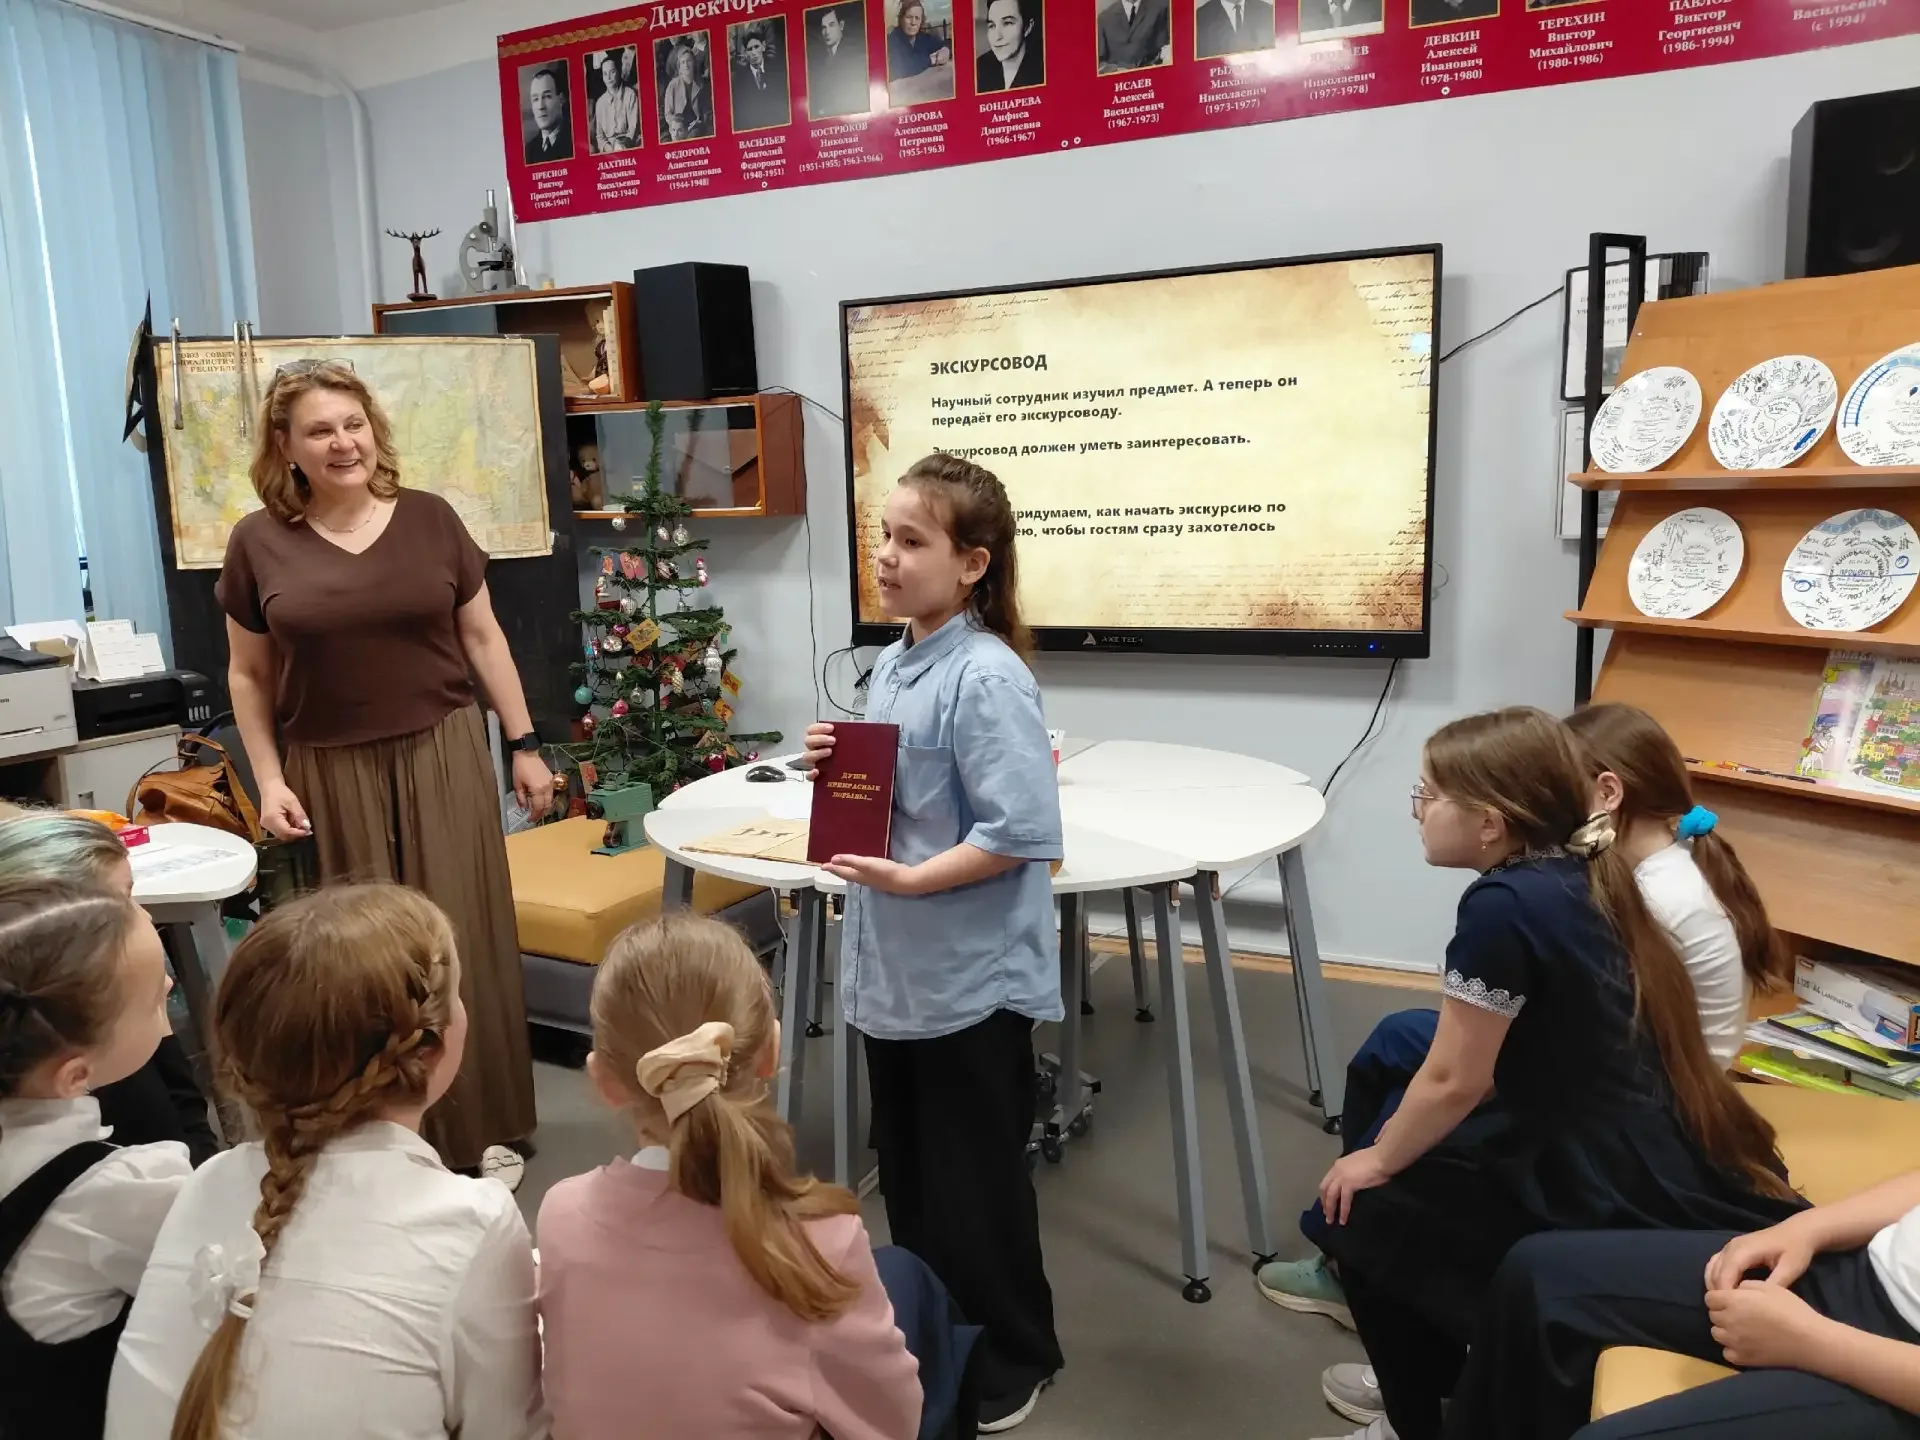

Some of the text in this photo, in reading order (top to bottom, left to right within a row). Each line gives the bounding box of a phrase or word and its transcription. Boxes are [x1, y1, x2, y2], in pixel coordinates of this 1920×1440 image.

[1669, 0, 1732, 12] ПАВЛО
[650, 0, 773, 32] Директор
[1538, 12, 1607, 31] ТЕРЕХИН
[1674, 9, 1727, 25] Виктор
[1828, 13, 1866, 30] 1994)
[1423, 29, 1482, 48] ДЕВКИН
[1546, 27, 1597, 43] Виктор
[1658, 20, 1742, 42] Георгиевич
[1426, 43, 1479, 60] Алексей
[1528, 38, 1615, 59] Михайлович
[1662, 34, 1735, 55] (1986-1994)
[1420, 56, 1484, 73] Иванович
[1537, 52, 1604, 72] (1980-1986)
[1114, 78, 1153, 93] ИСАЕВ
[1303, 71, 1376, 89] Николаевич
[1420, 69, 1483, 87] (1978-1980)
[1111, 89, 1156, 105] Алексей
[1199, 86, 1268, 104] Николаевич
[1309, 83, 1369, 101] (1977-1978)
[979, 95, 1042, 113] БОНДАРЕВА
[1103, 101, 1165, 118] Васильевич
[1205, 98, 1261, 115] (1973-1977)
[898, 110, 943, 125] ЕГОРОВА
[991, 110, 1030, 123] Анфиса
[1107, 113, 1160, 130] (1967-1973)
[810, 121, 868, 138] КОСТРЮКОВ
[893, 122, 948, 137] Александра
[980, 120, 1042, 137] Дмитриевна
[739, 135, 786, 149] ВАСИЛЬЕВ
[820, 134, 859, 149] Николай
[899, 133, 944, 148] Петровна
[986, 131, 1036, 148] (1966-1967)
[664, 146, 711, 161] ФЕДОРОВА
[742, 146, 784, 160] Анатолий
[816, 146, 864, 160] Андреевич
[898, 144, 945, 160] (1955-1963)
[597, 157, 638, 171] ЛАХТИНА
[667, 157, 709, 170] Анастасия
[740, 158, 787, 171] Федорович
[799, 153, 884, 174] (1951-1955; 1963-1966)
[531, 169, 569, 181] ПРЕСНОВ
[600, 168, 636, 181] Людмила
[656, 167, 723, 183] Константиновна
[743, 168, 785, 181] (1948-1951)
[537, 179, 564, 191] Виктор
[597, 178, 641, 192] Васильевна
[669, 178, 710, 192] (1944-1948)
[530, 188, 574, 202] Прохорович
[600, 188, 639, 201] (1942-1944)
[534, 198, 570, 211] (1936-1941)
[930, 354, 1048, 375] ЭКСКУРСОВОД
[931, 375, 1298, 411] Научный сотрудник изучил предмет. А теперь он
[931, 406, 1123, 428] передаёт его экскурсоводу.
[1021, 441, 1076, 457] должен
[1079, 438, 1123, 455] уметь
[1126, 432, 1252, 453] заинтересовать.
[1096, 506, 1121, 517] как
[1124, 504, 1175, 517] начать
[1178, 502, 1262, 519] экскурсию
[1266, 501, 1286, 514] по
[1042, 524, 1086, 536] чтобы
[1090, 524, 1139, 536] гостям
[1143, 523, 1183, 538] сразу
[1187, 520, 1275, 535] захотелось
[841, 772, 867, 780] ДУШИ
[827, 781, 881, 791] ПРЕКРАСНЫЕ
